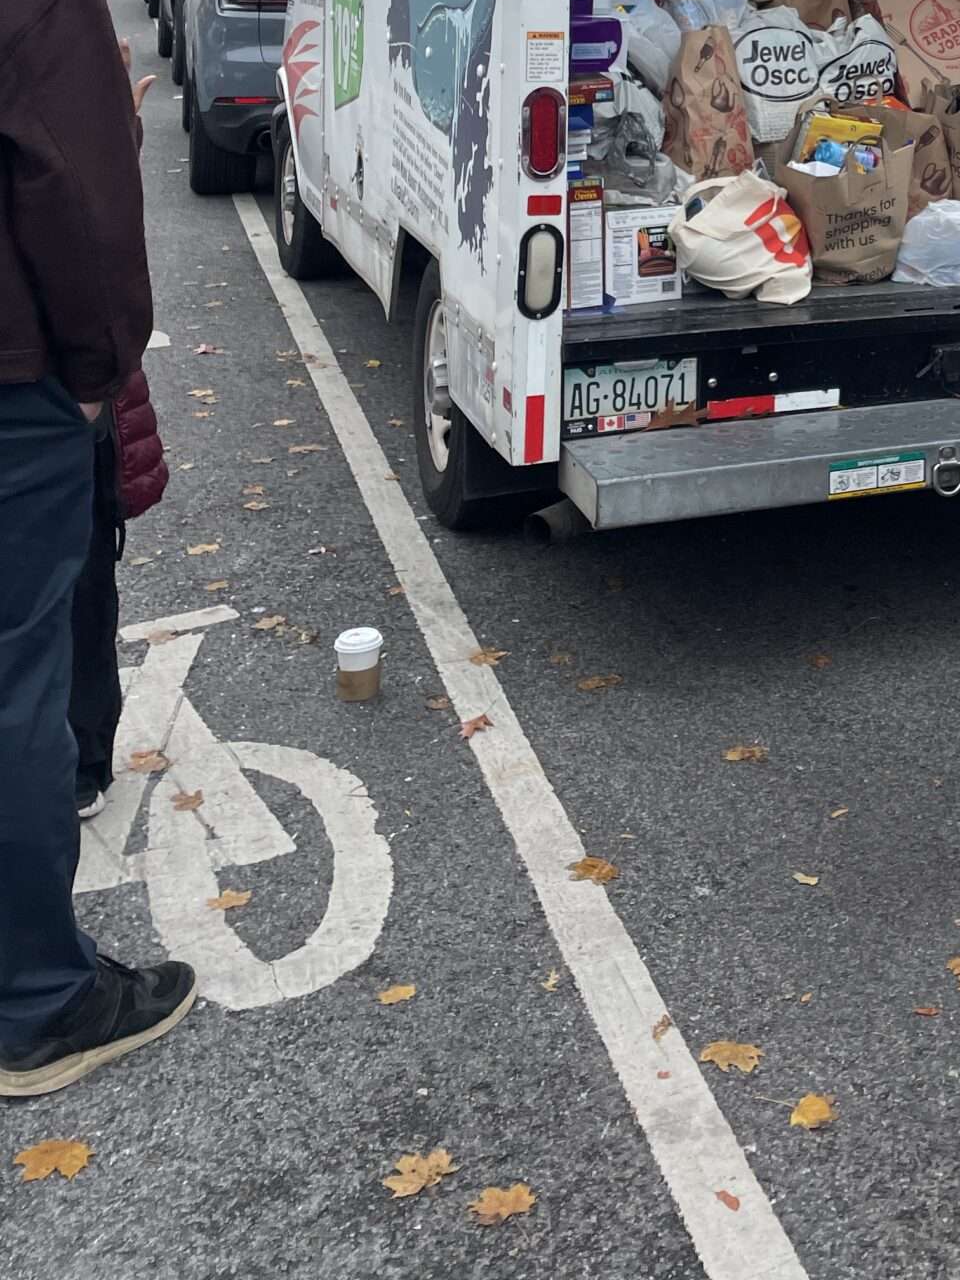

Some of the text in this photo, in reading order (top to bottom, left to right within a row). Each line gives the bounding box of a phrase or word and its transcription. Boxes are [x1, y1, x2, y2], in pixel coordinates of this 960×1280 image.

[742, 40, 806, 64] Jewel
[828, 52, 892, 84] Jewel
[834, 78, 893, 103] Osco
[825, 197, 896, 225] Thanks for
[825, 215, 892, 240] shopping
[824, 236, 856, 252] with
